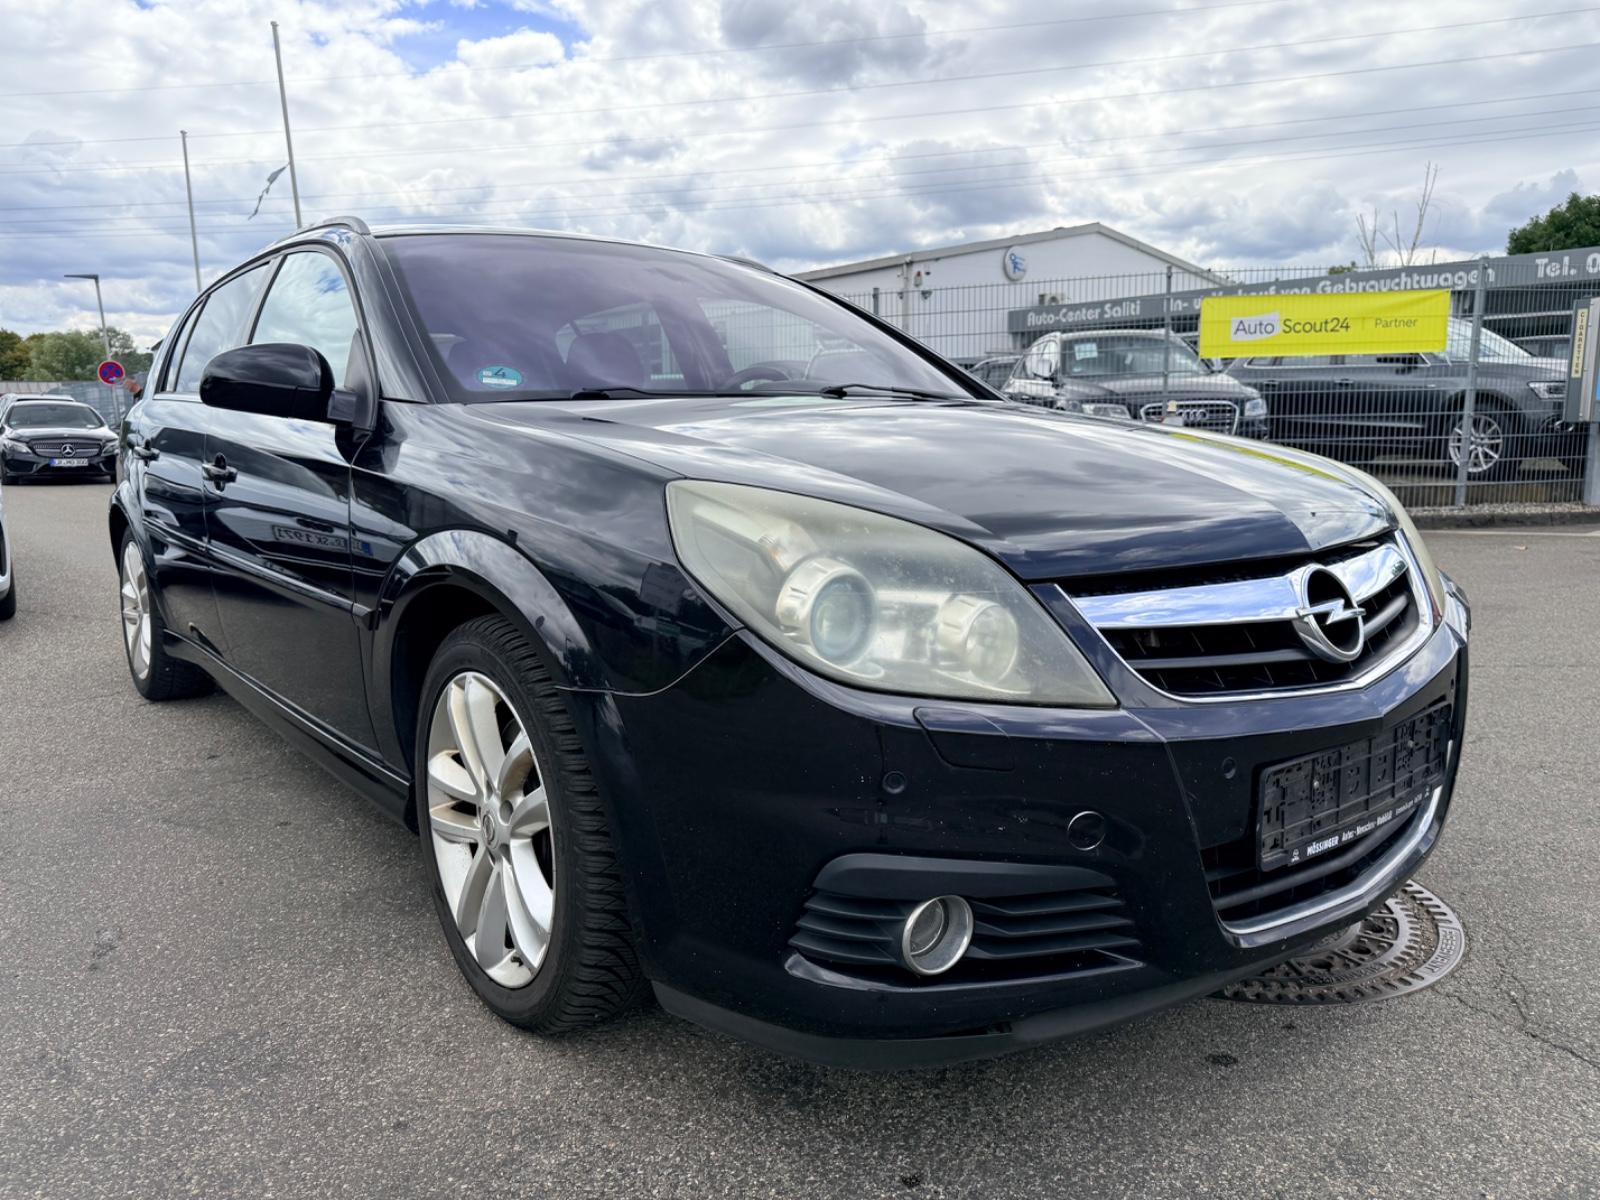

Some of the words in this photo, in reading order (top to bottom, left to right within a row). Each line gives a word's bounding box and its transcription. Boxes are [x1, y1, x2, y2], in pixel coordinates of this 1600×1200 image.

[1535, 256, 1577, 278] Tel.
[1316, 267, 1496, 294] Gebrauchtwagen
[1027, 308, 1101, 327] Auto-Center
[1104, 300, 1141, 319] Saliti
[1233, 319, 1275, 335] Auto
[1282, 317, 1351, 335] Scout24
[1374, 316, 1418, 329] Partner
[494, 368, 506, 378] 4
